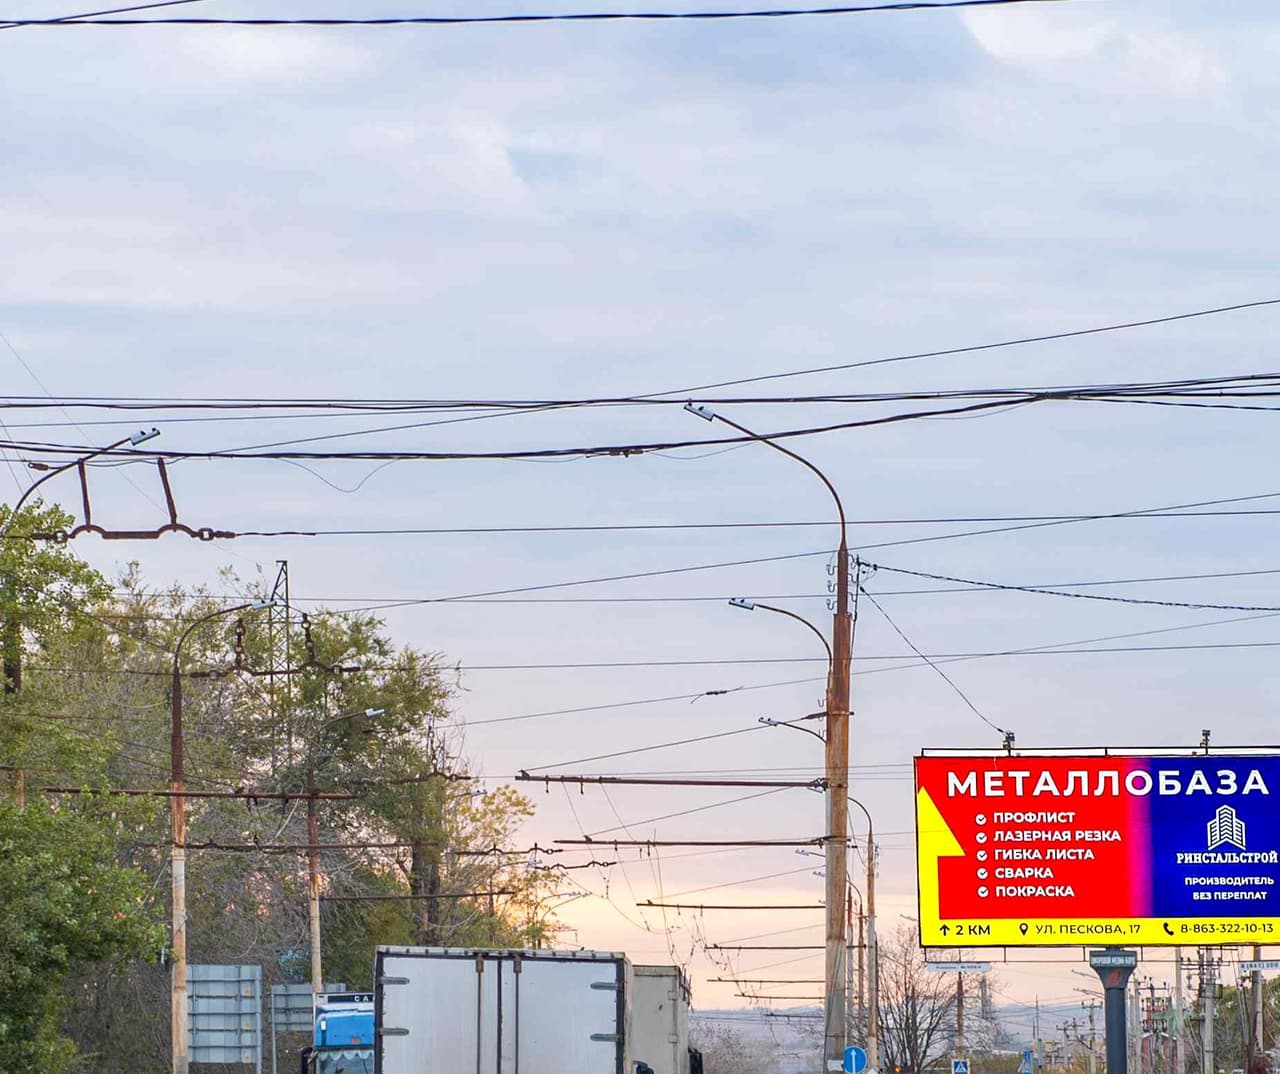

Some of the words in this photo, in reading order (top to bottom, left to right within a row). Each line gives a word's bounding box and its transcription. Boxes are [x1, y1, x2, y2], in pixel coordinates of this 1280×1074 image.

[946, 768, 1270, 797] МЕТАЛЛОБАЗА
[993, 811, 1076, 824] ПРОФЛИСТ
[993, 830, 1071, 842] ЛАЗЕРНАЯ
[1074, 829, 1122, 842] РЕЗКА
[994, 848, 1043, 861] ГИБКА
[1045, 848, 1095, 860] ЛИСТА
[1176, 850, 1279, 864] РИНСТАЛЬСТРОЙ
[994, 867, 1054, 879] СВАРКА
[1184, 876, 1275, 887] ПРОИЗВОДИТЕЛЬ
[995, 885, 1075, 897] ПОКРАСКА
[1192, 891, 1212, 900] БЕЗ
[1213, 891, 1268, 900] ПЕРЕПЛАТ
[955, 924, 964, 936] 2
[968, 924, 991, 936] КМ
[1035, 924, 1056, 935] УЛ.
[1059, 924, 1126, 936] ПЕСКОВА,
[1129, 924, 1141, 934] 17
[1180, 923, 1274, 933] 8-863-322-10-13
